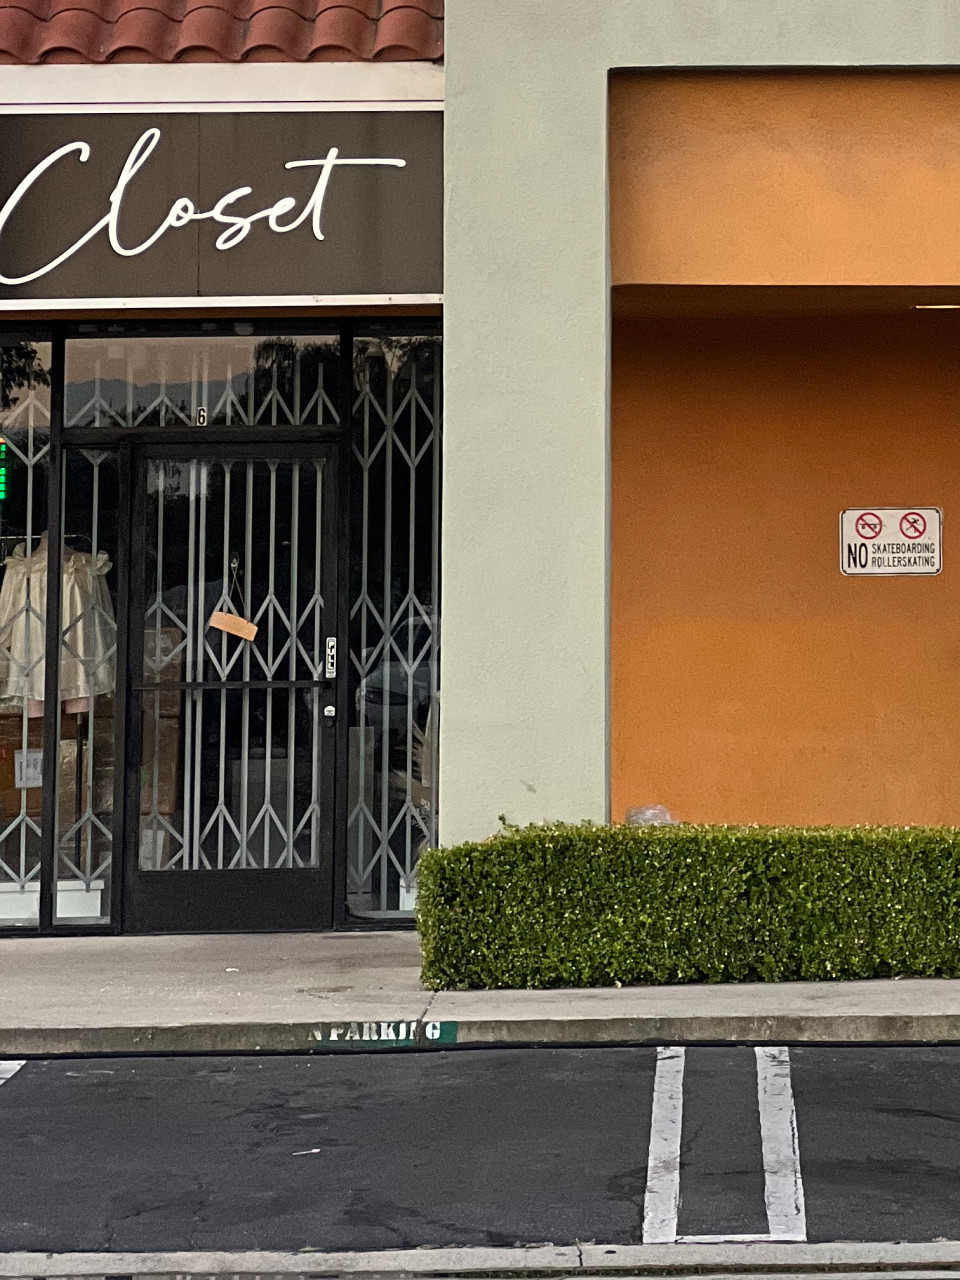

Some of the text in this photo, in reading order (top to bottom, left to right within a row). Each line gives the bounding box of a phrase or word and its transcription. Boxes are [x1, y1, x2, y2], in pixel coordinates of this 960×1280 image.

[0, 127, 407, 285] Closet
[197, 407, 206, 426] 6
[847, 542, 935, 568] NO SKATEBOARDING
[872, 556, 935, 568] ROLLERSKATING
